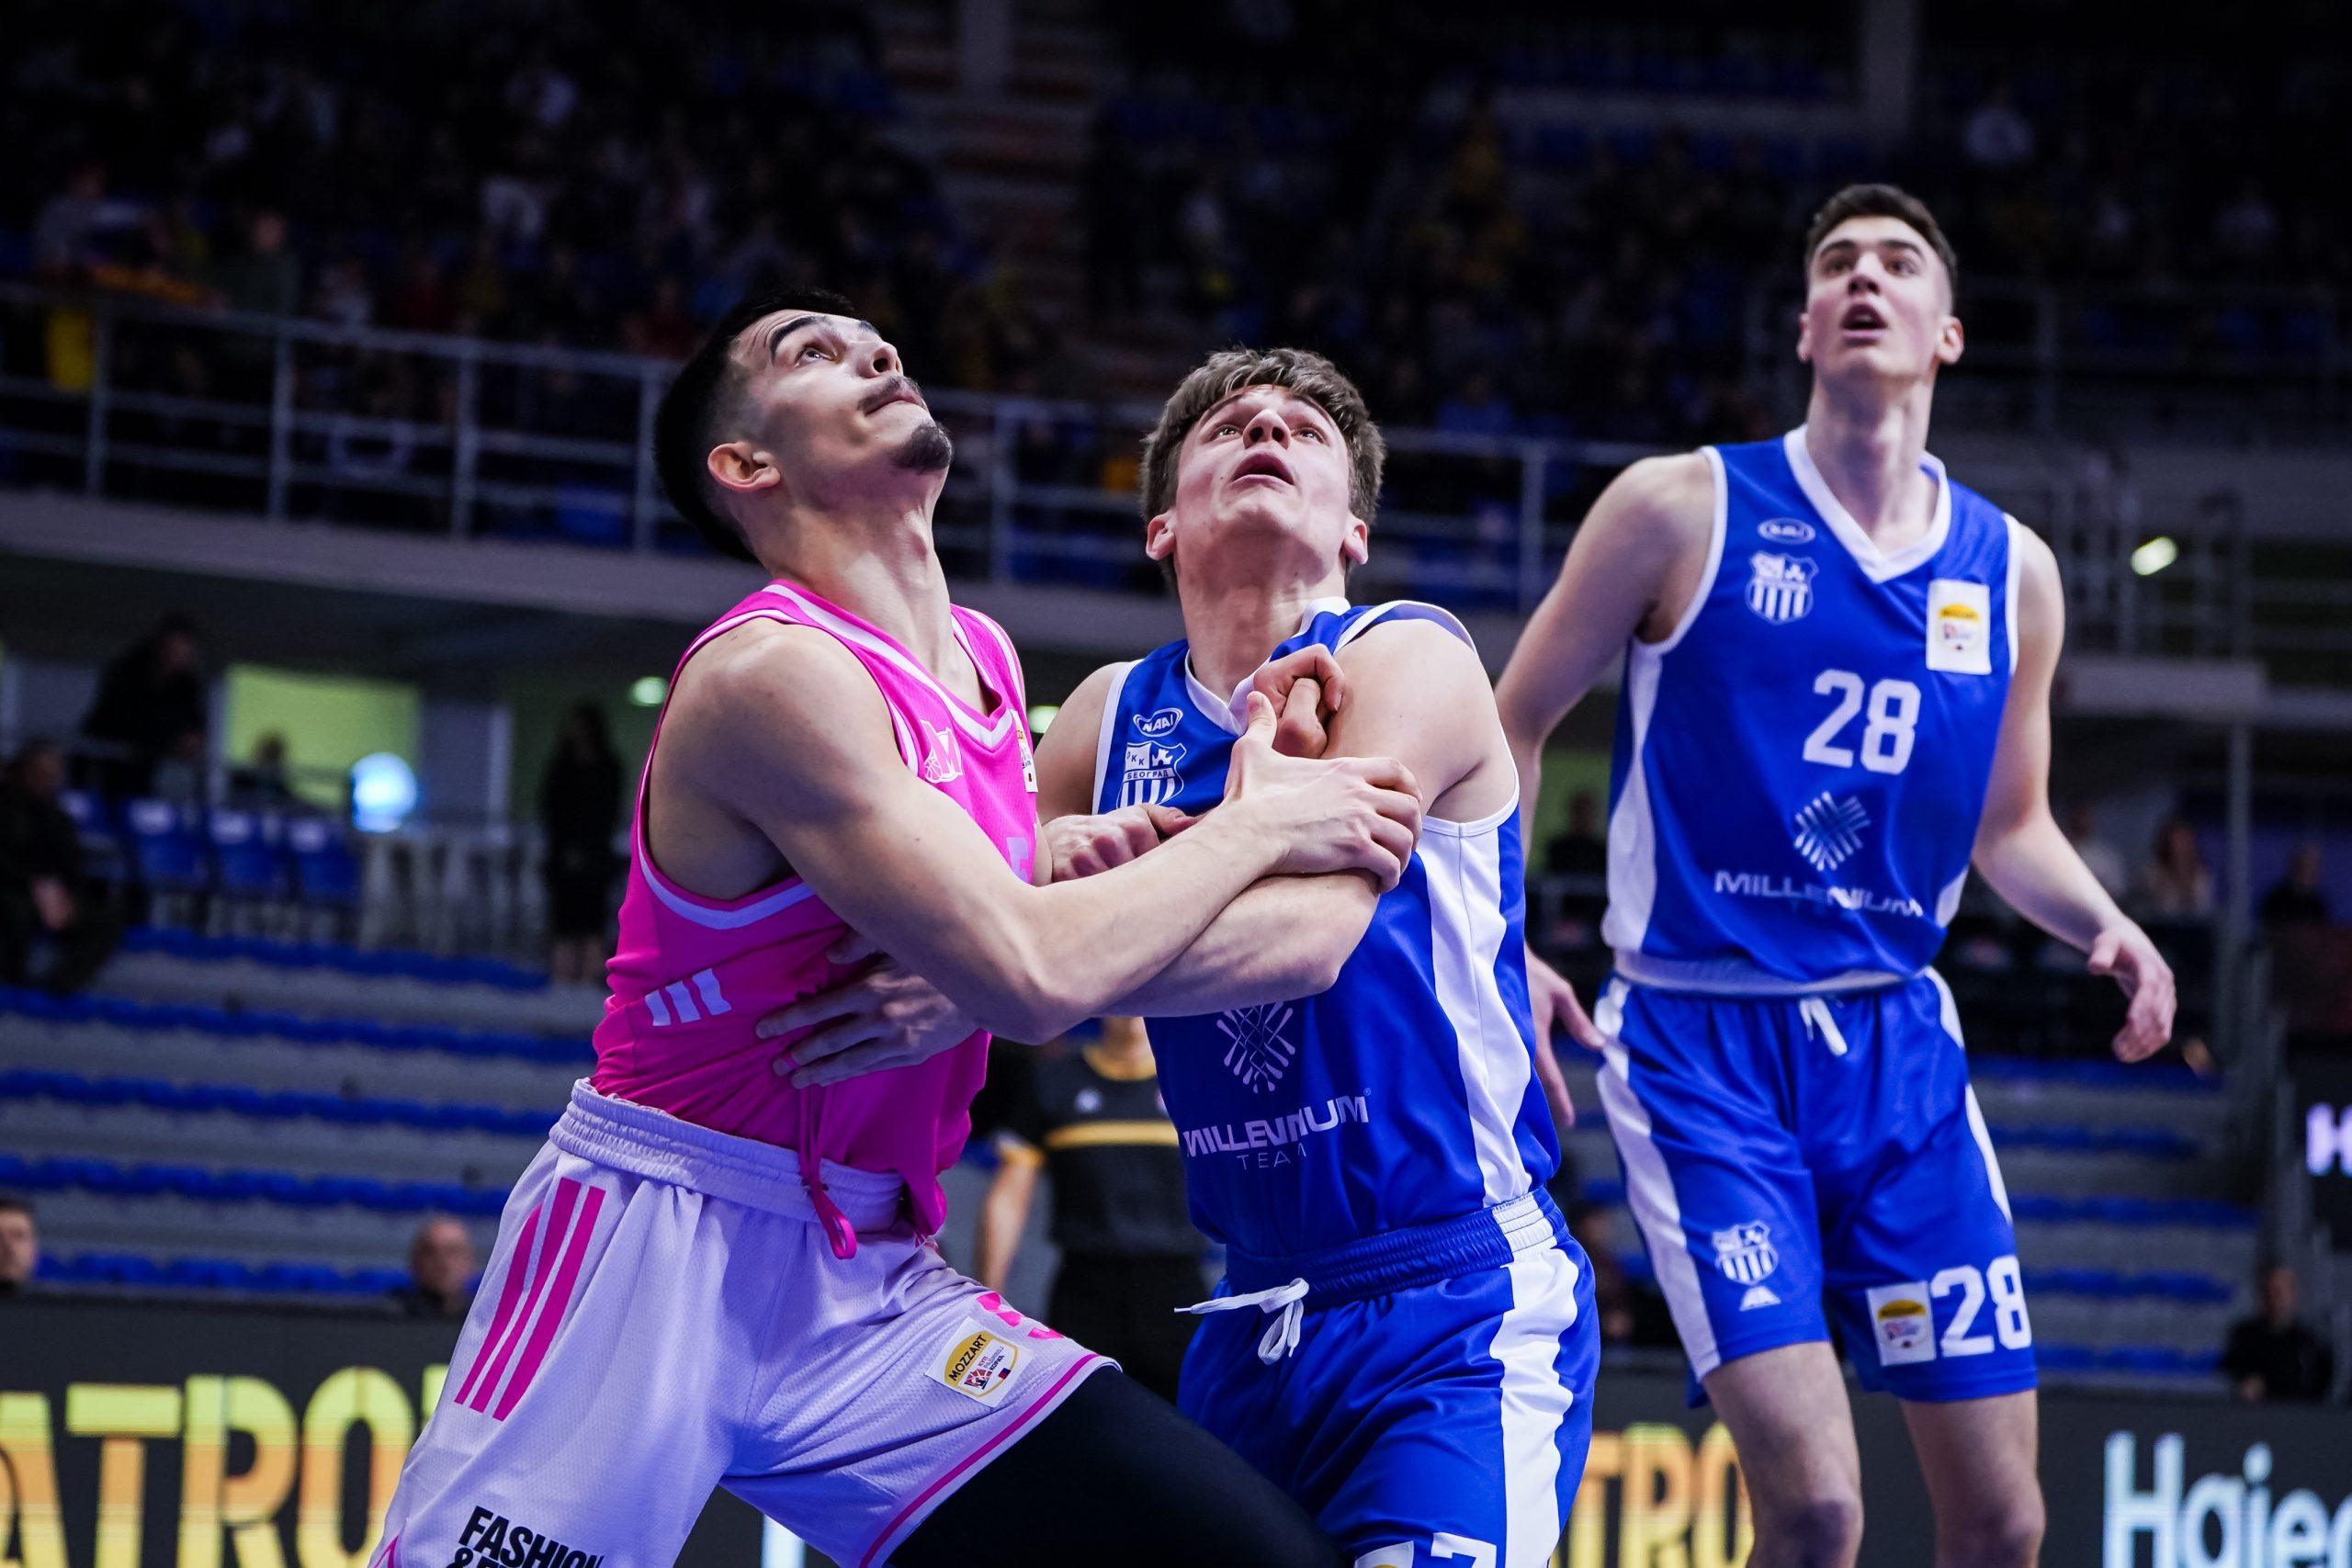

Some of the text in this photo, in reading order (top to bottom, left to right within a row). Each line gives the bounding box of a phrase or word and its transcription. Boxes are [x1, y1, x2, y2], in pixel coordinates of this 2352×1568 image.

[1802, 669, 1921, 775] 28
[1126, 769, 1169, 781] БЕОГРАД
[948, 1334, 988, 1382] MOZZART
[1930, 1254, 2032, 1358] 28
[0, 1365, 450, 1568] ATRO
[1551, 1422, 1755, 1568] TRO
[458, 1505, 605, 1568] FASHI
